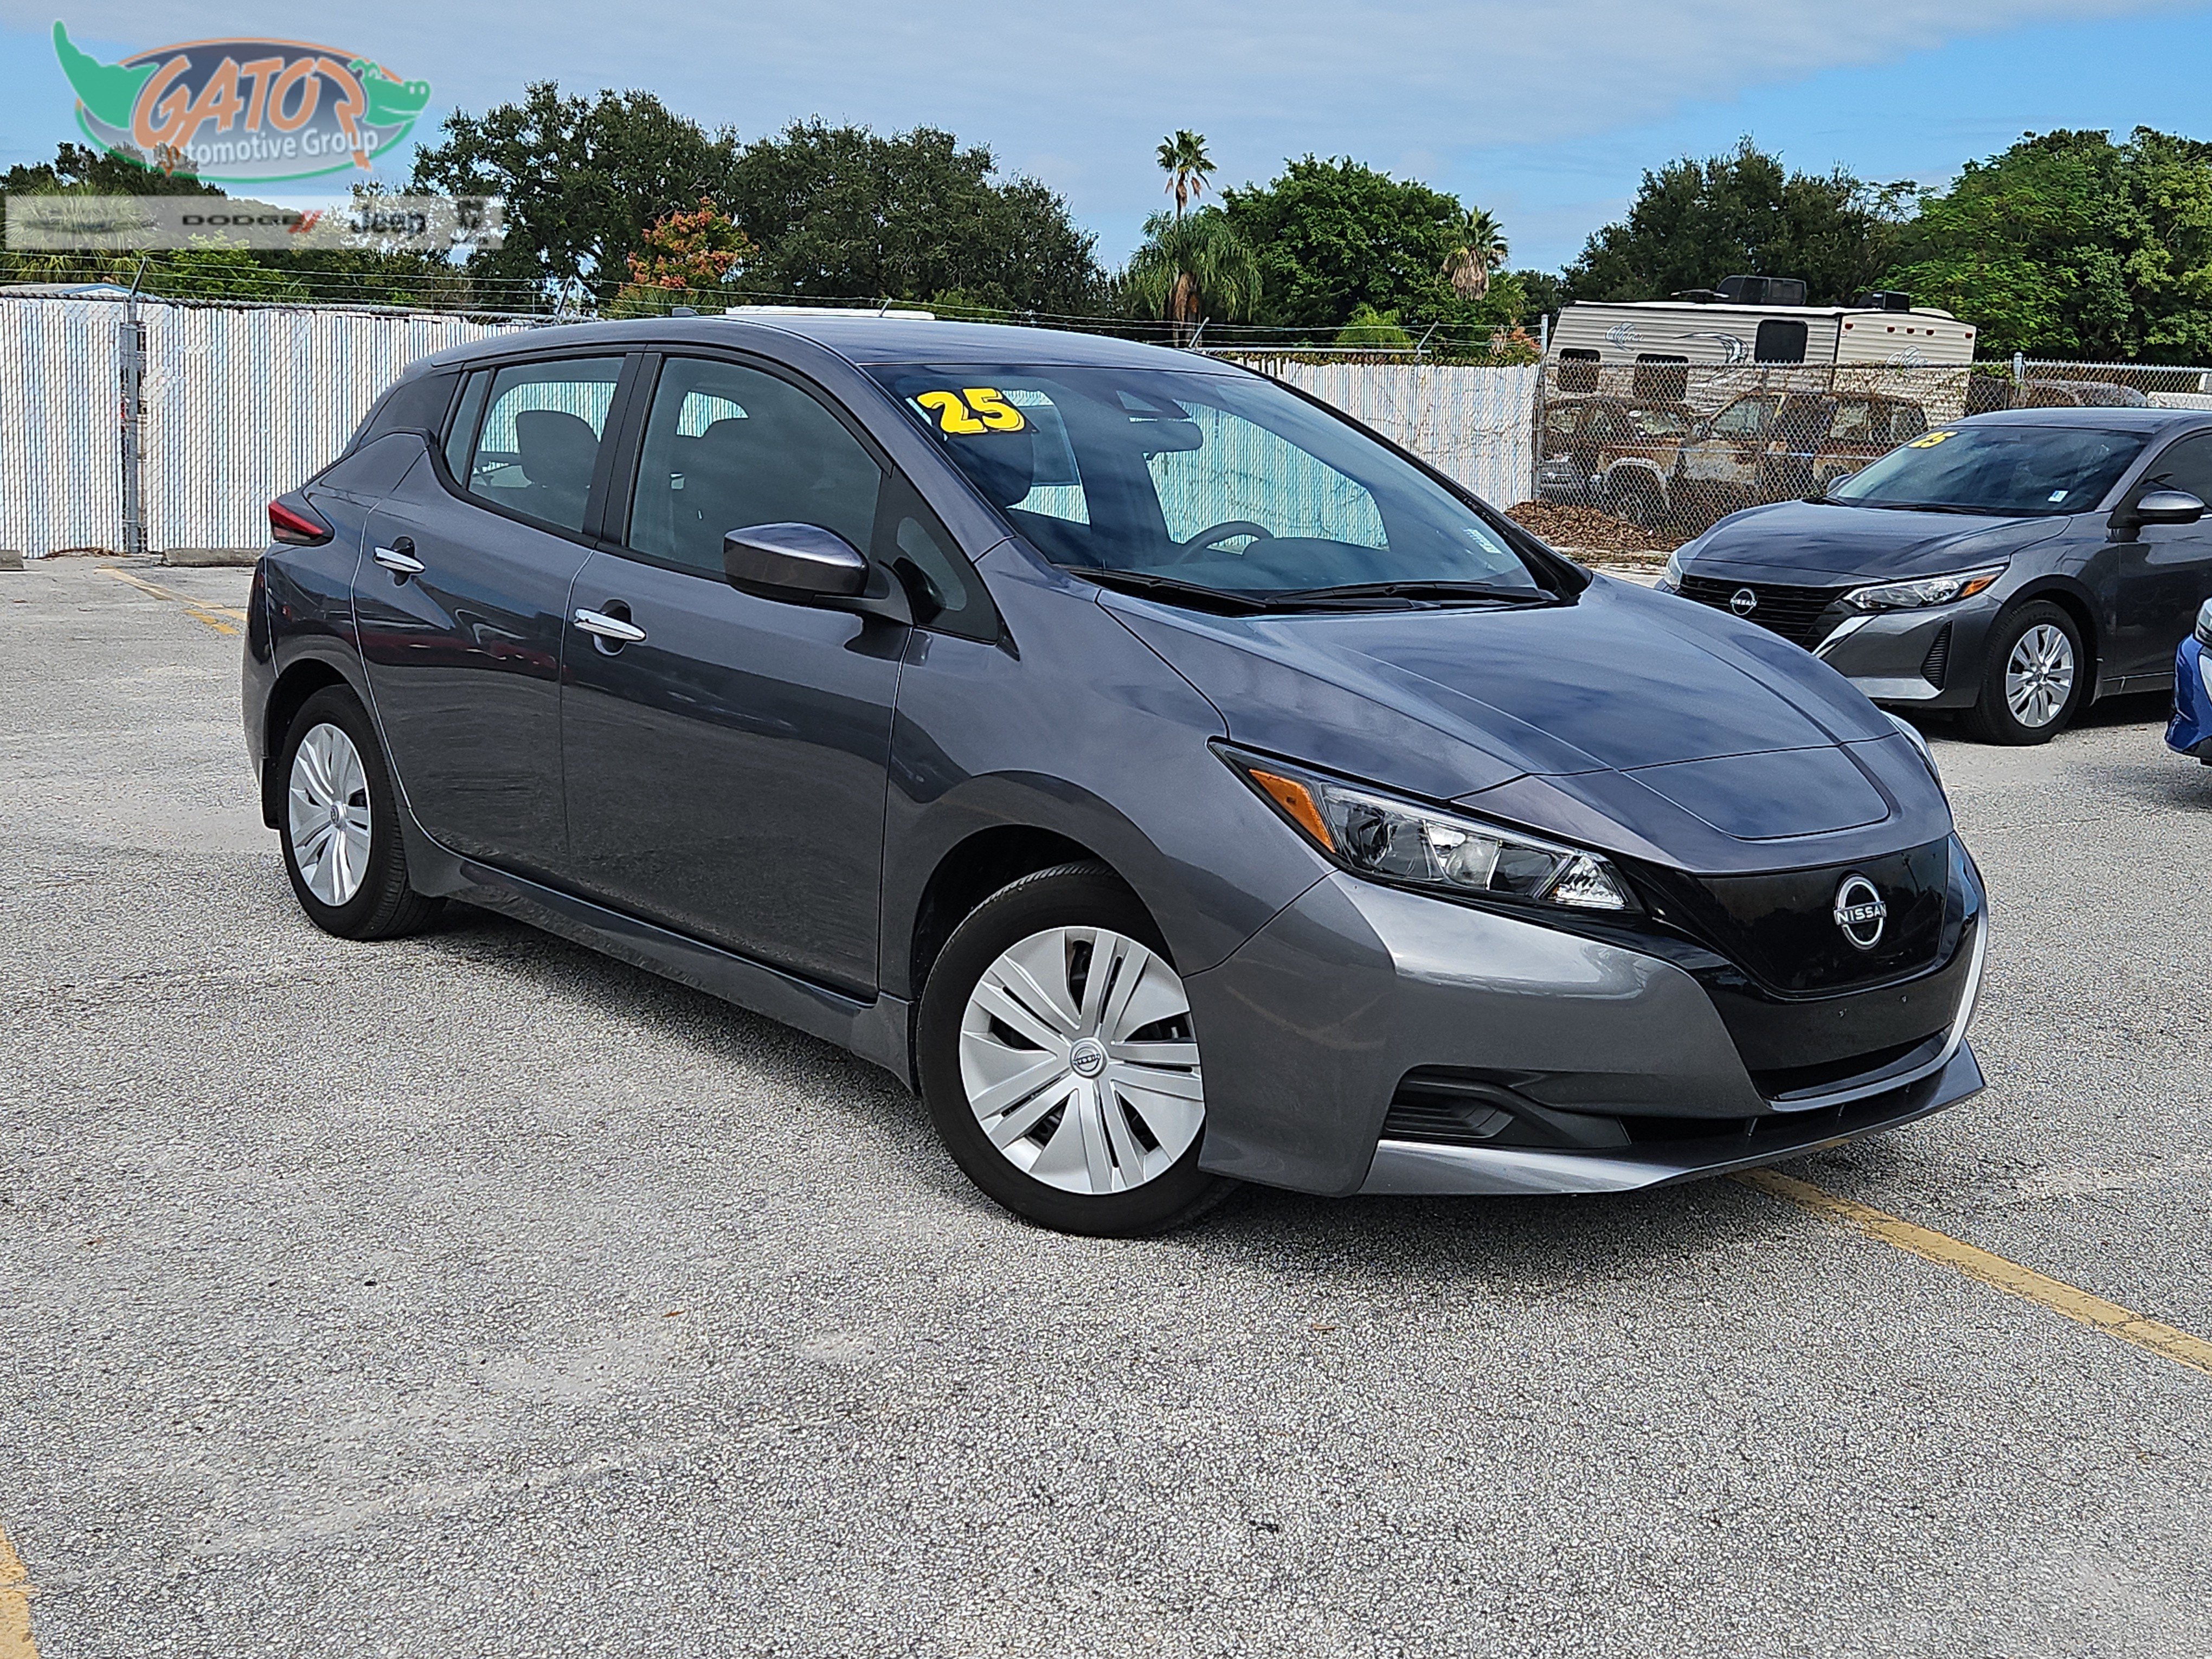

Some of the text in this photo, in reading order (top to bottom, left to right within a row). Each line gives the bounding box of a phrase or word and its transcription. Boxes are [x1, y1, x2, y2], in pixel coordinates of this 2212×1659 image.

[917, 387, 1025, 434] 25
[1907, 430, 1958, 448] 25
[1835, 903, 1887, 925] NISSAN
